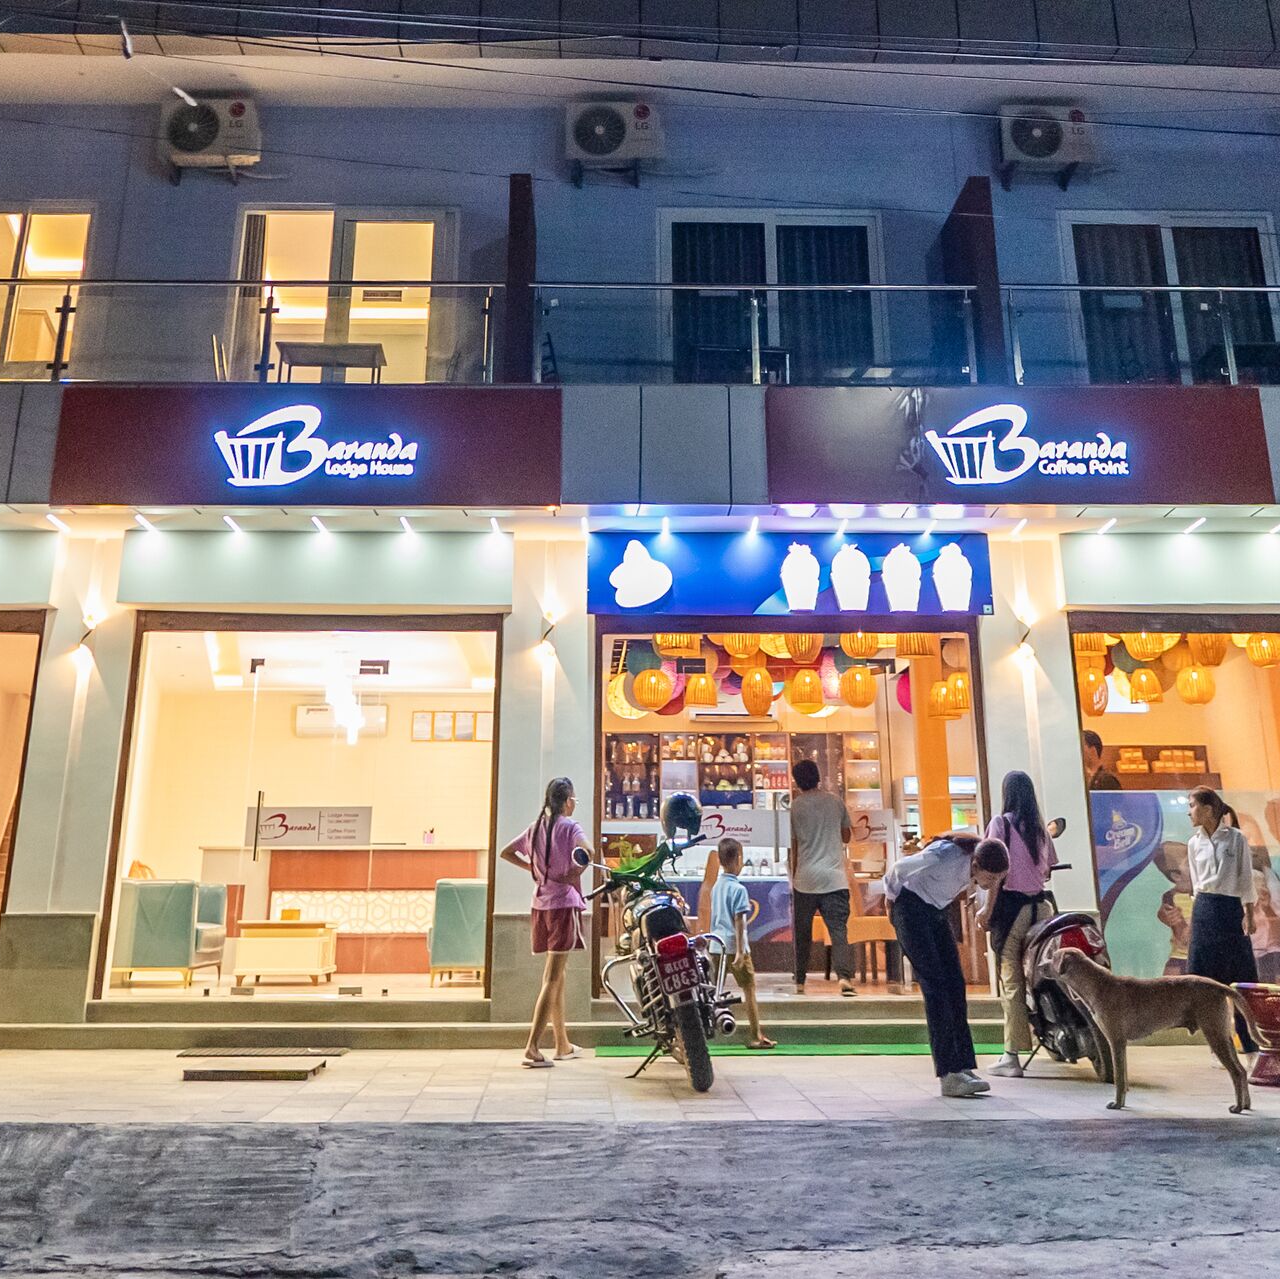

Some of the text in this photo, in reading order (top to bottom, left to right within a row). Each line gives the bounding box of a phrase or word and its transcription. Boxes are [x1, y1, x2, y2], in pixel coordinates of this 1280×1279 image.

[635, 121, 649, 131] LG
[214, 404, 418, 487] Baranda
[925, 403, 1127, 485] Baranda
[325, 460, 414, 478] Lodge House
[1038, 459, 1130, 475] Coffee Point
[700, 813, 753, 840] Baranda
